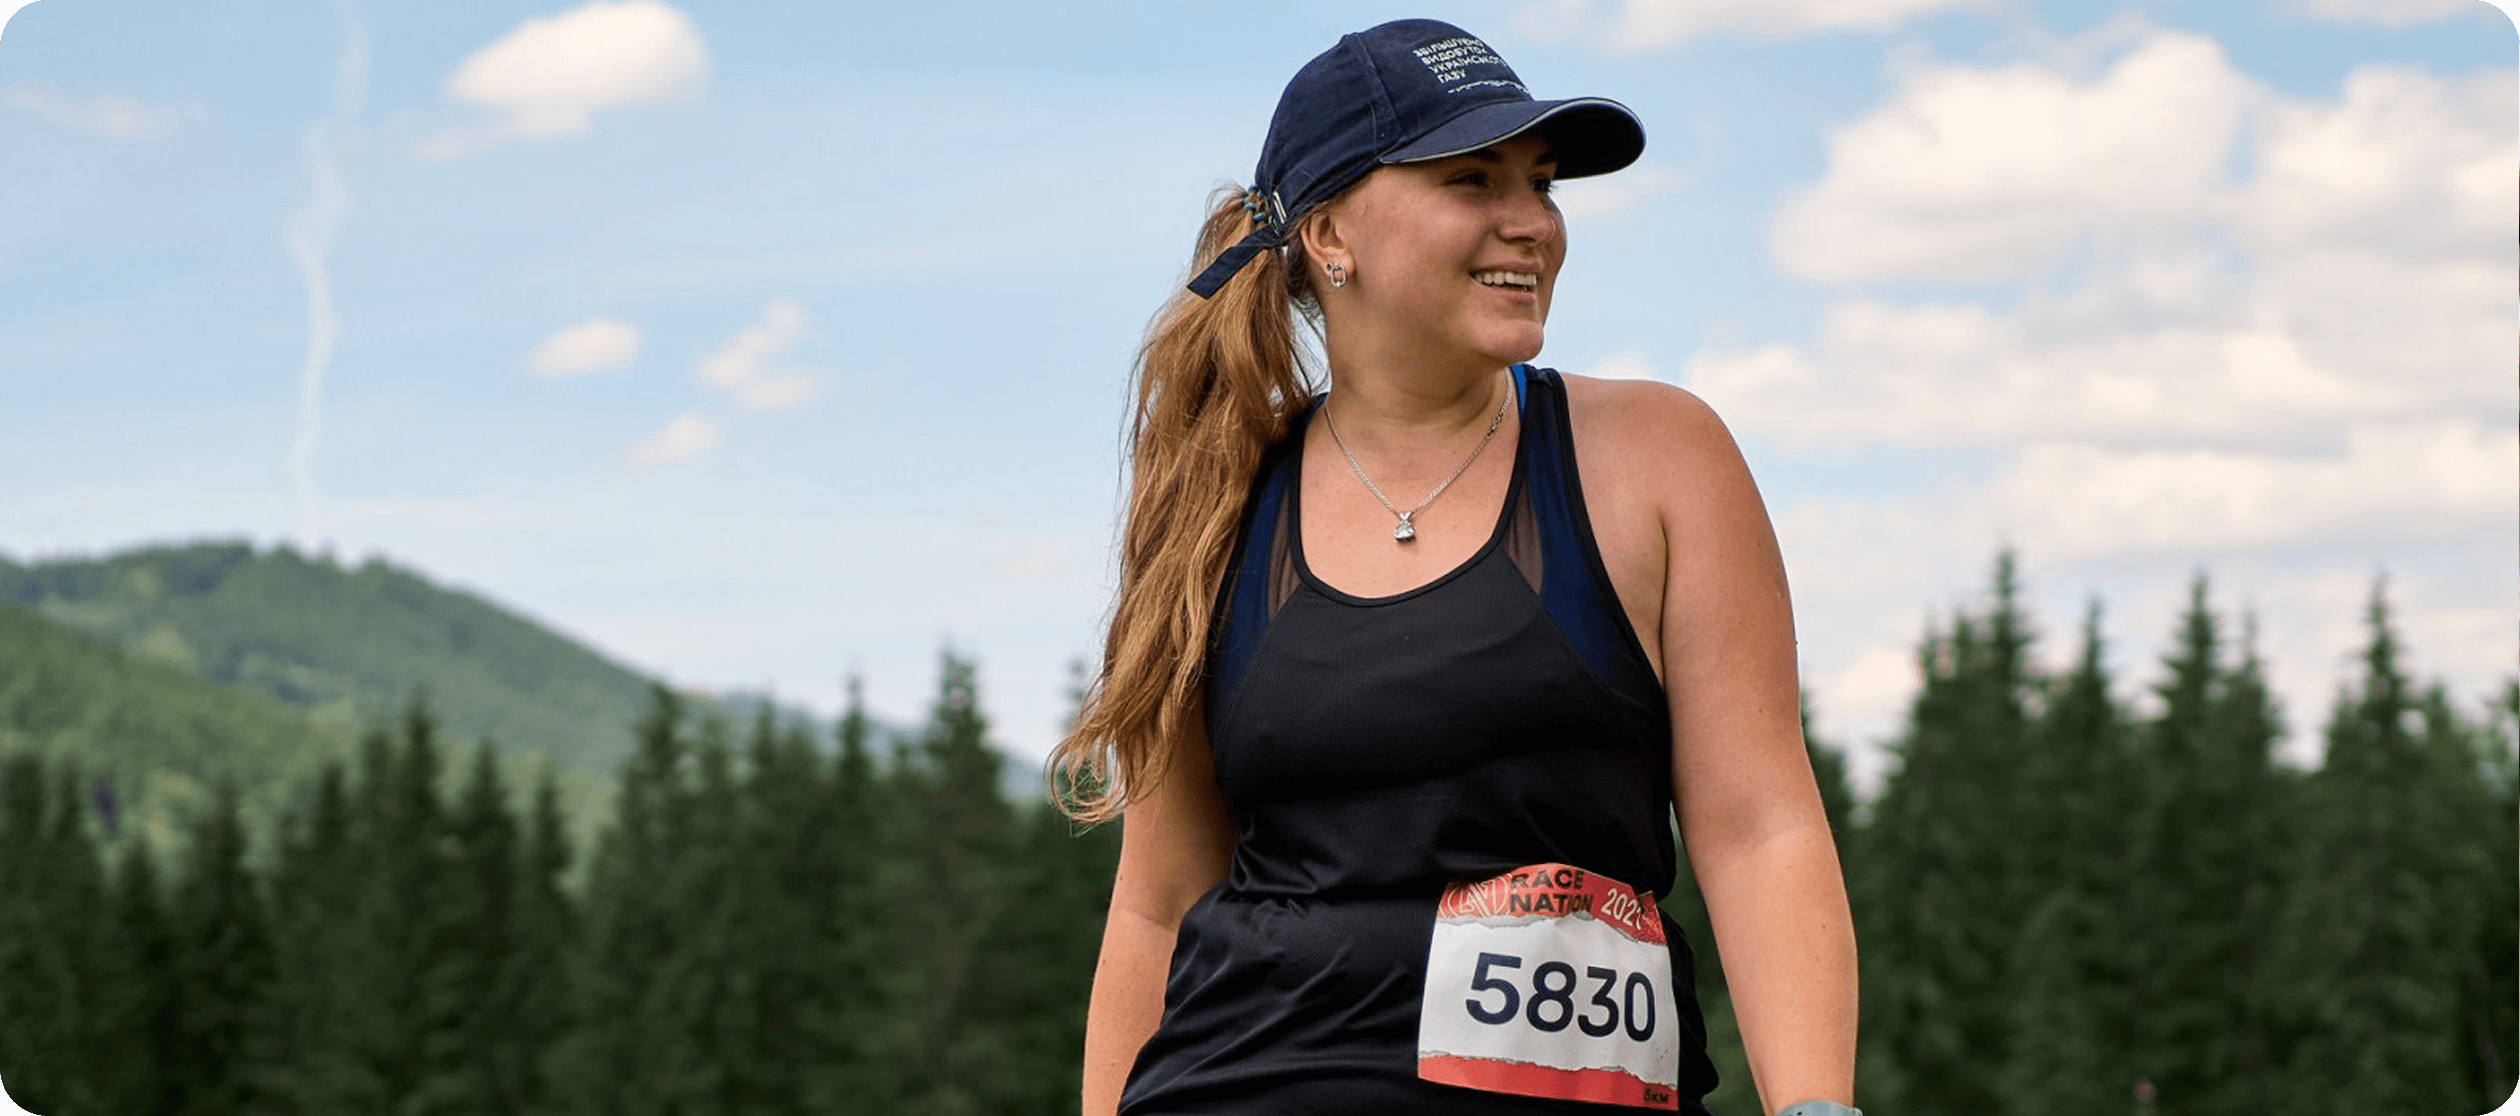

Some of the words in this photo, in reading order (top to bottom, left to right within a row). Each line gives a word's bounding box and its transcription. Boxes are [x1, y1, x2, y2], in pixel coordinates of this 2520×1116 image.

[1421, 46, 1487, 65] ВИДОБУТОК
[1428, 54, 1507, 72] УКРАЇНСЬКО
[1437, 69, 1466, 83] ГАЗУ
[1510, 870, 1584, 889] RACE
[1510, 893, 1593, 912] NATION
[1466, 952, 1655, 1041] 5830
